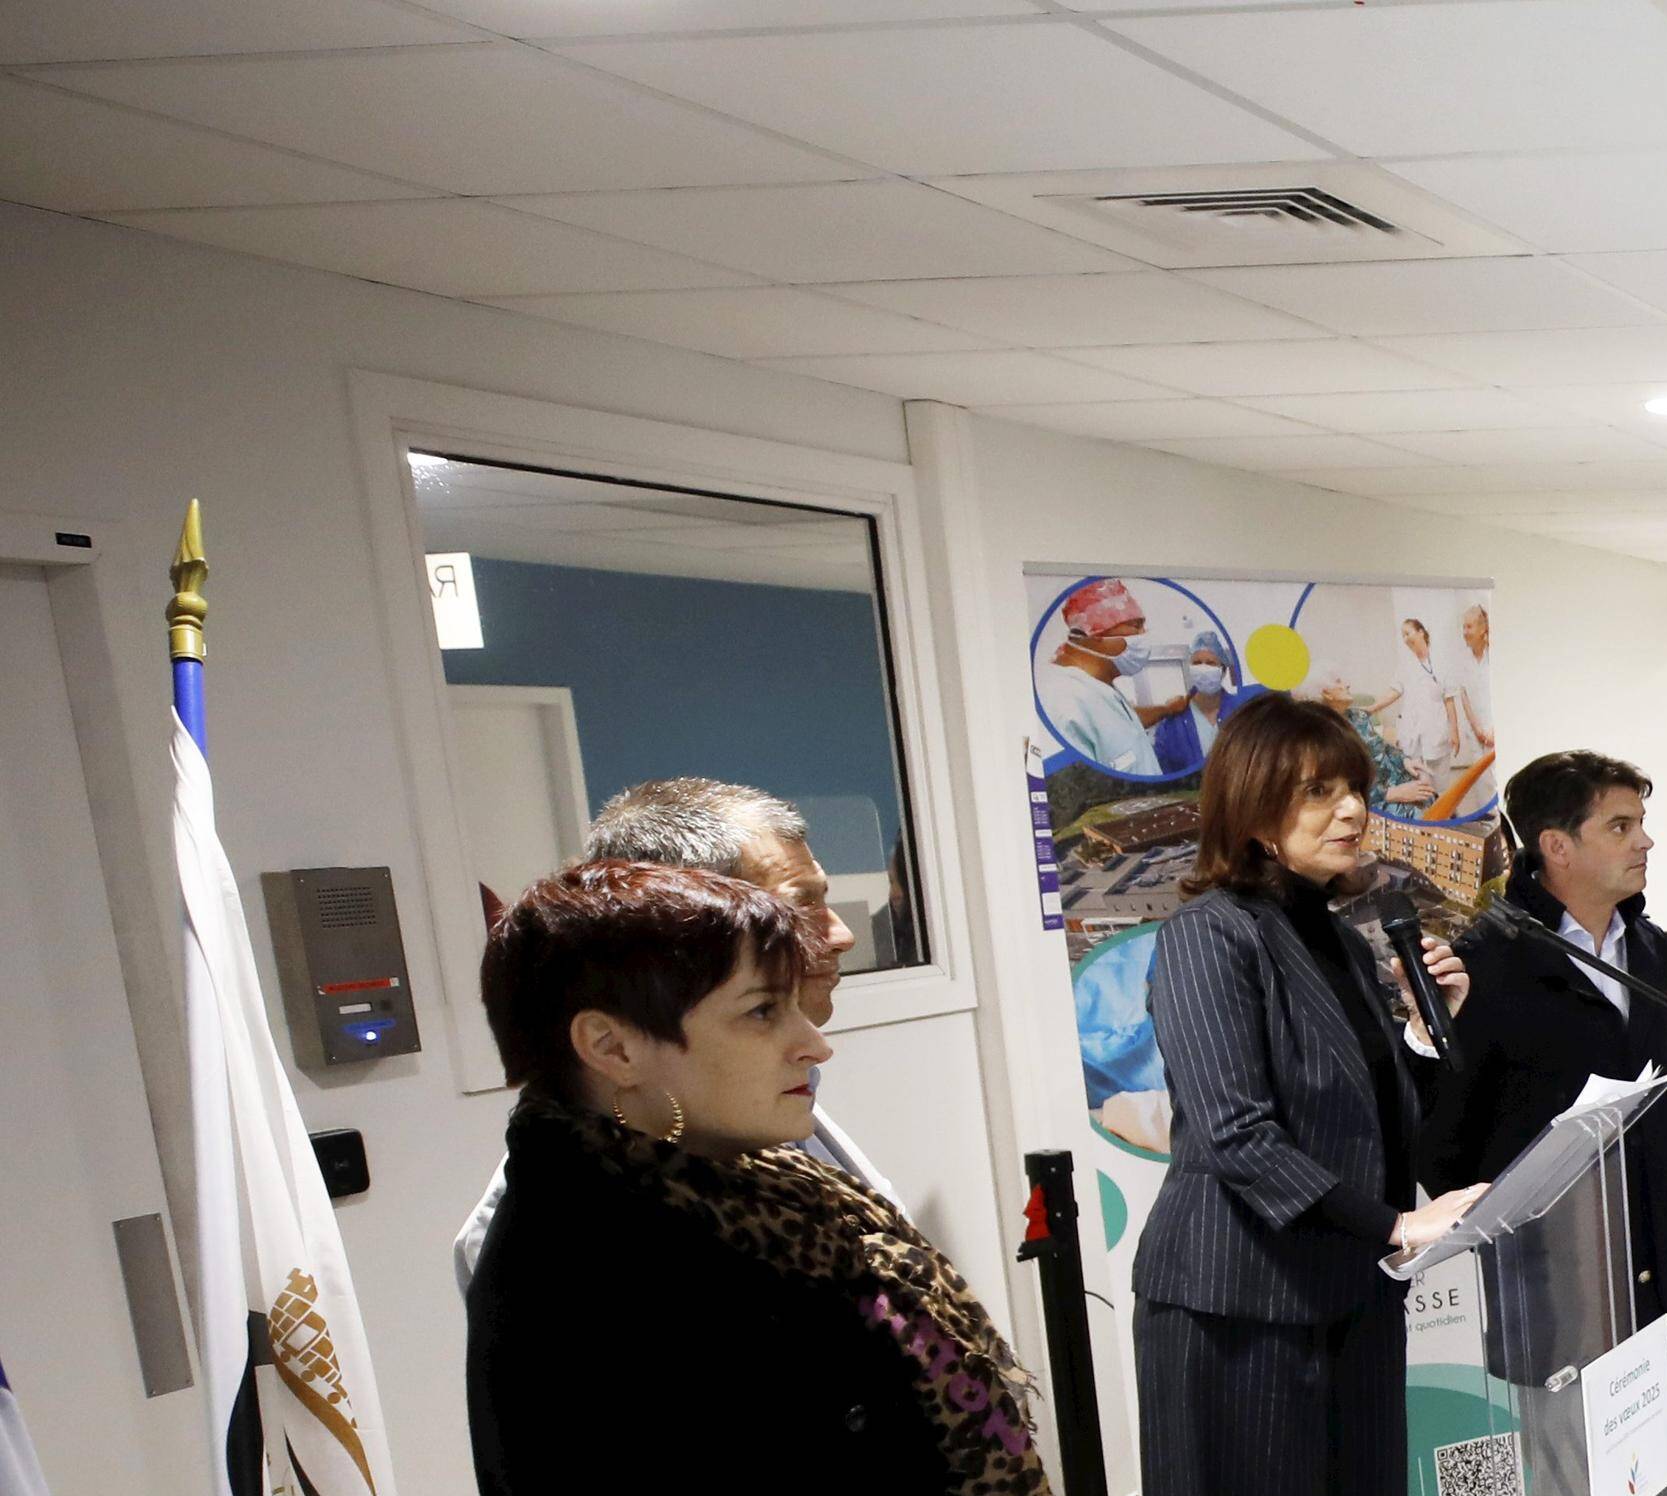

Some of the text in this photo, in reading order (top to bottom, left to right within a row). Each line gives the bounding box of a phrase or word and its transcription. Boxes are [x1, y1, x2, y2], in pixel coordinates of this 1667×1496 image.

[1609, 1357, 1651, 1397] Cérémonie
[1603, 1417, 1618, 1437] des
[1641, 1381, 1661, 1409] 2025
